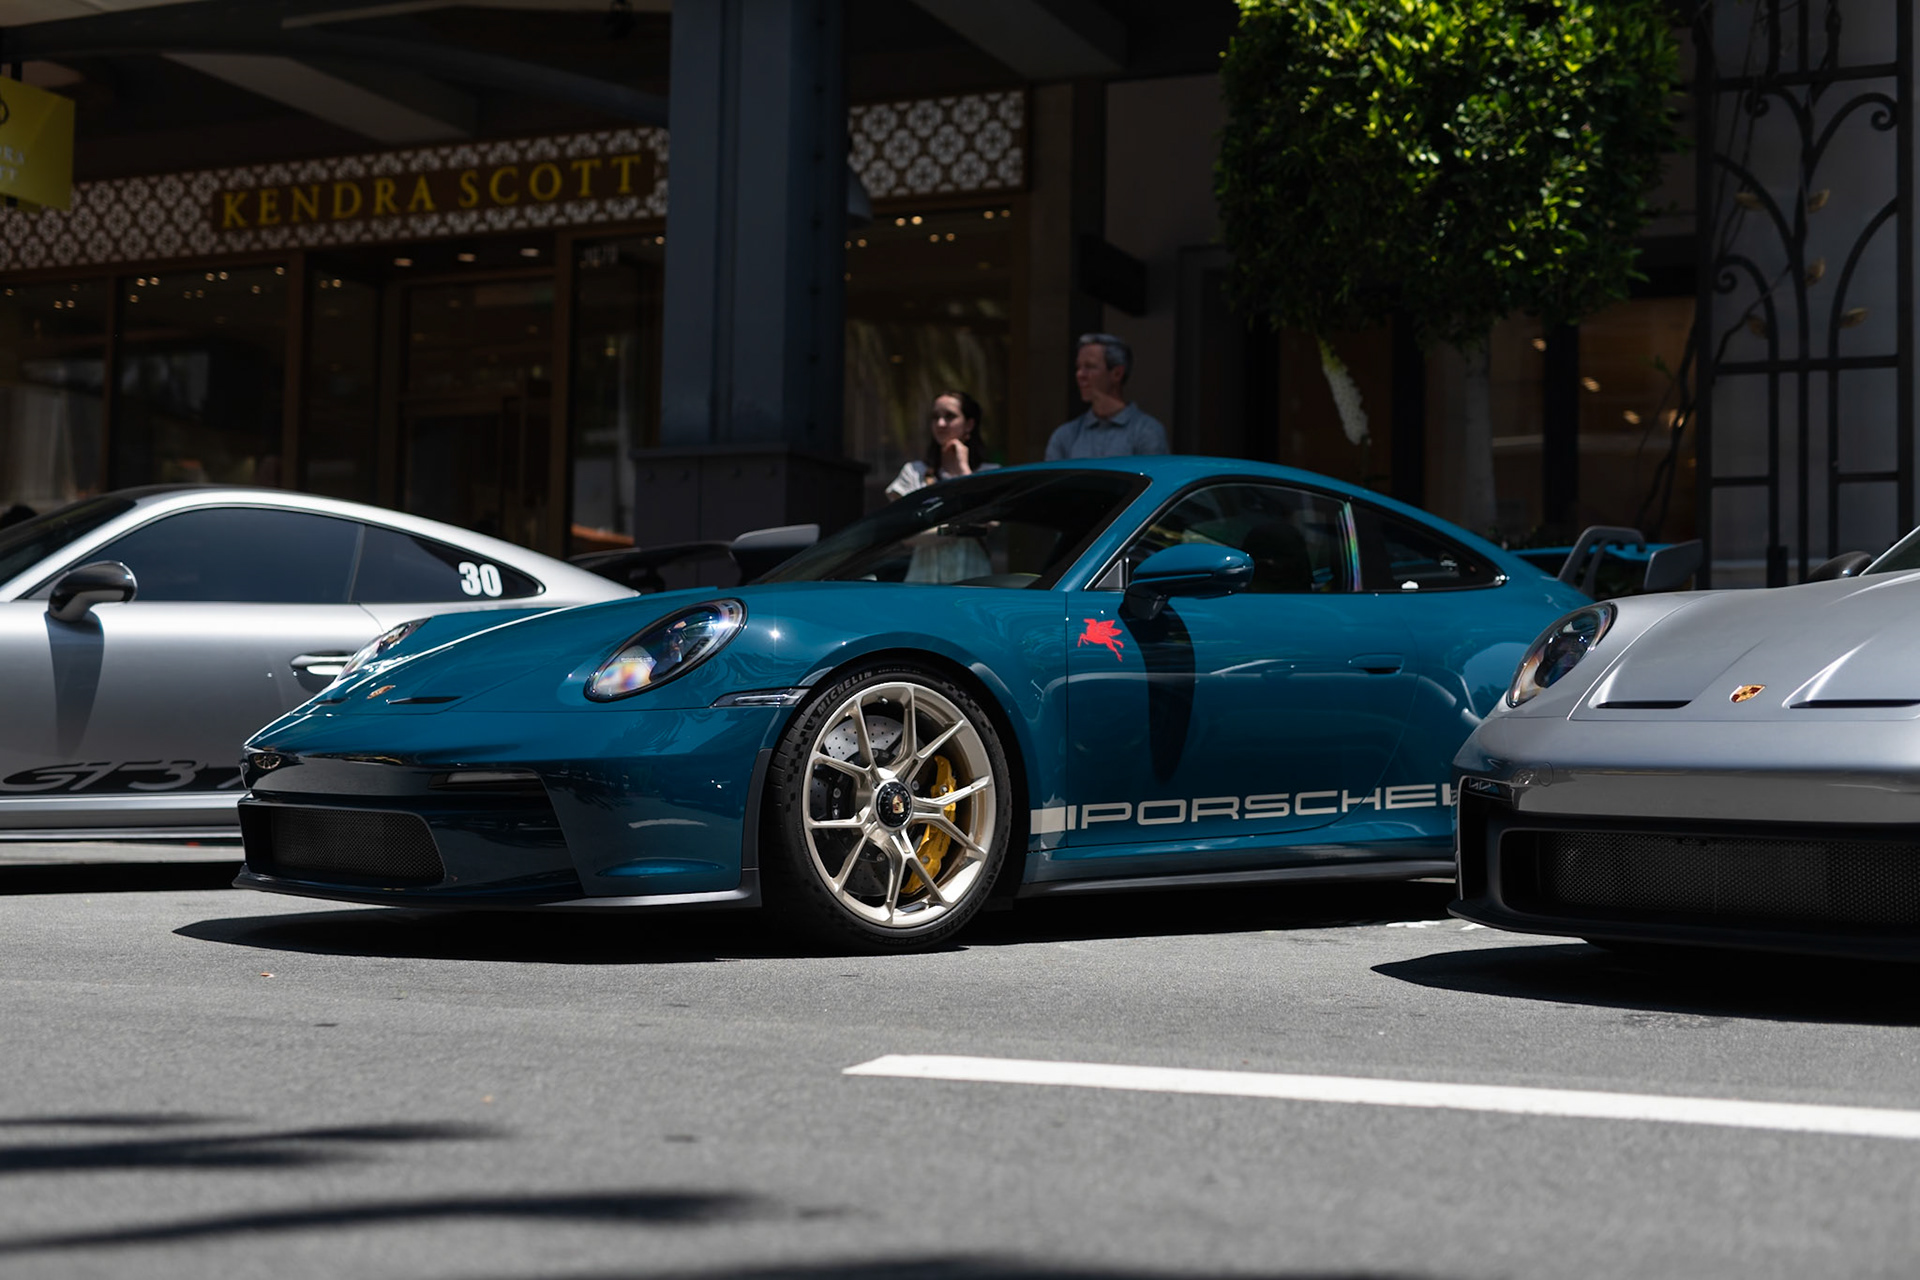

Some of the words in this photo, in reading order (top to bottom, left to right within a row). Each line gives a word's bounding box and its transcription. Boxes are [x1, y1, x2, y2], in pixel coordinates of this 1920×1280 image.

[221, 175, 436, 229] KENDRA
[458, 155, 642, 208] SCOTT
[458, 561, 503, 597] 30
[816, 671, 872, 715] MICHELIN
[1080, 783, 1437, 829] PORSCHE
